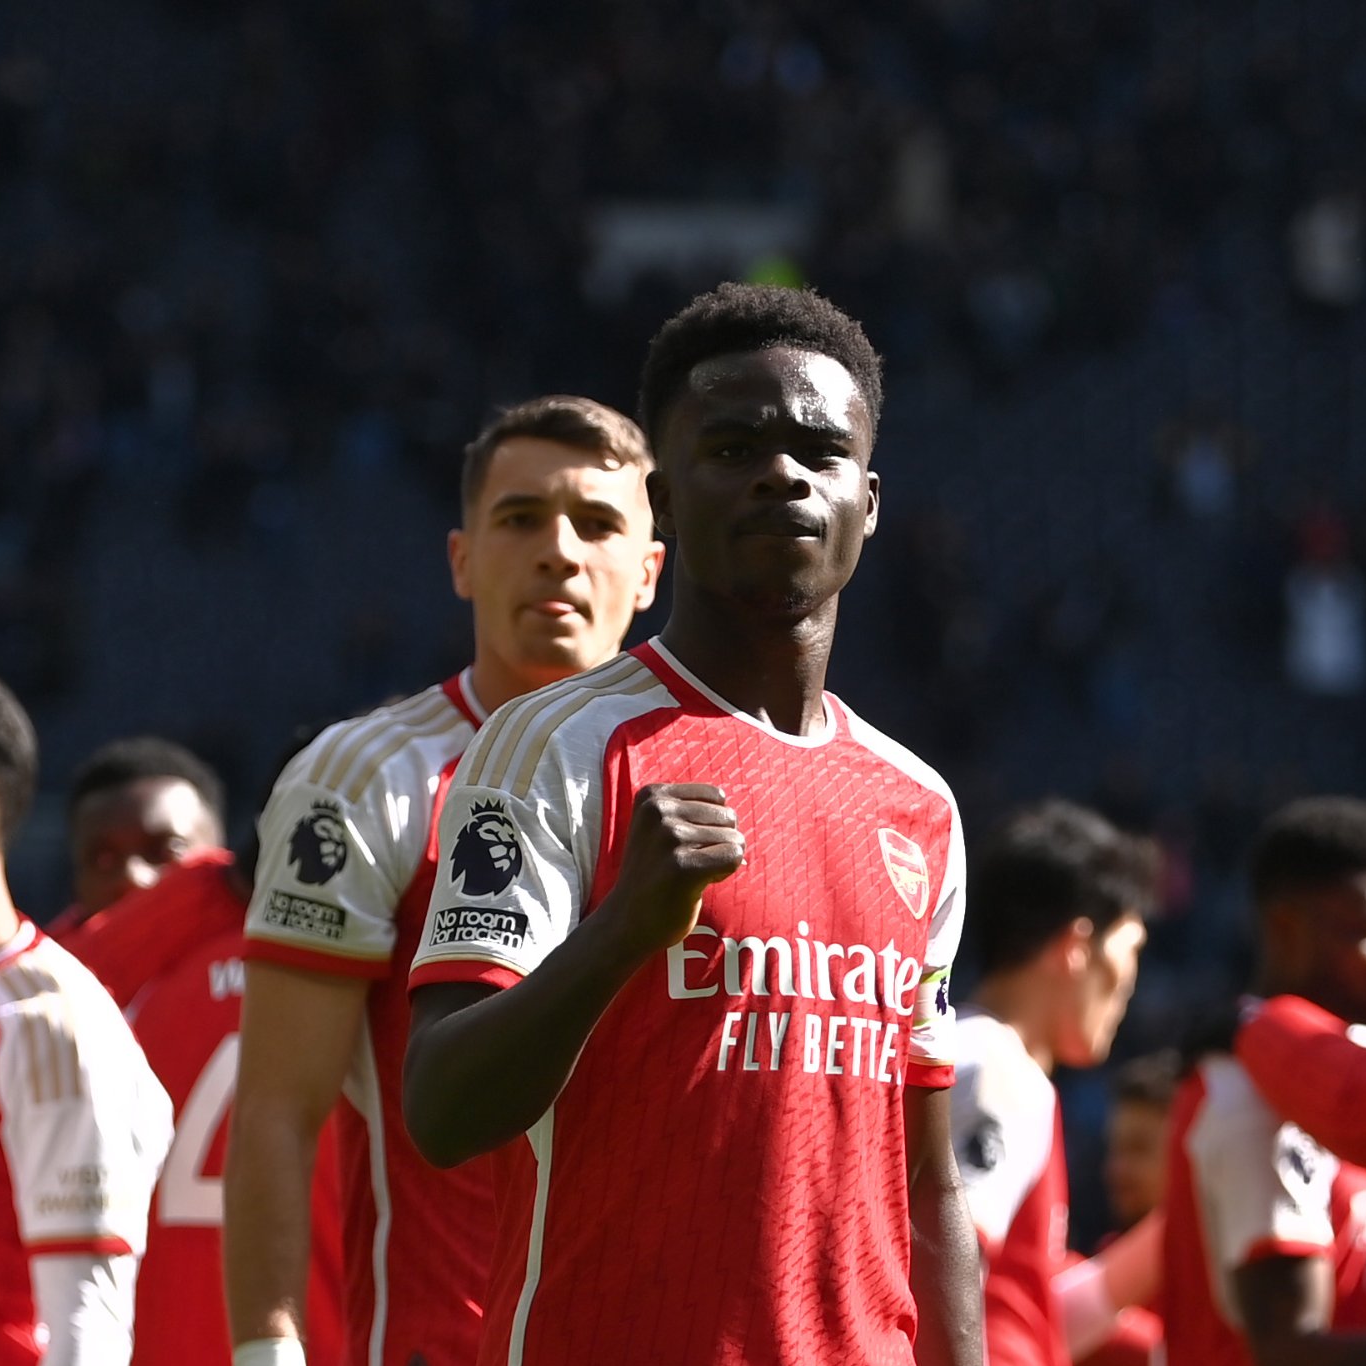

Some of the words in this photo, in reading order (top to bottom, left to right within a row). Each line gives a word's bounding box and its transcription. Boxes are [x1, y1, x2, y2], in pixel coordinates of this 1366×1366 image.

[435, 910, 457, 930] No
[459, 910, 517, 932] room
[455, 926, 524, 949] racism
[666, 920, 922, 1016] Emirate
[717, 1011, 791, 1071] FLY
[802, 1013, 903, 1085] BETTE
